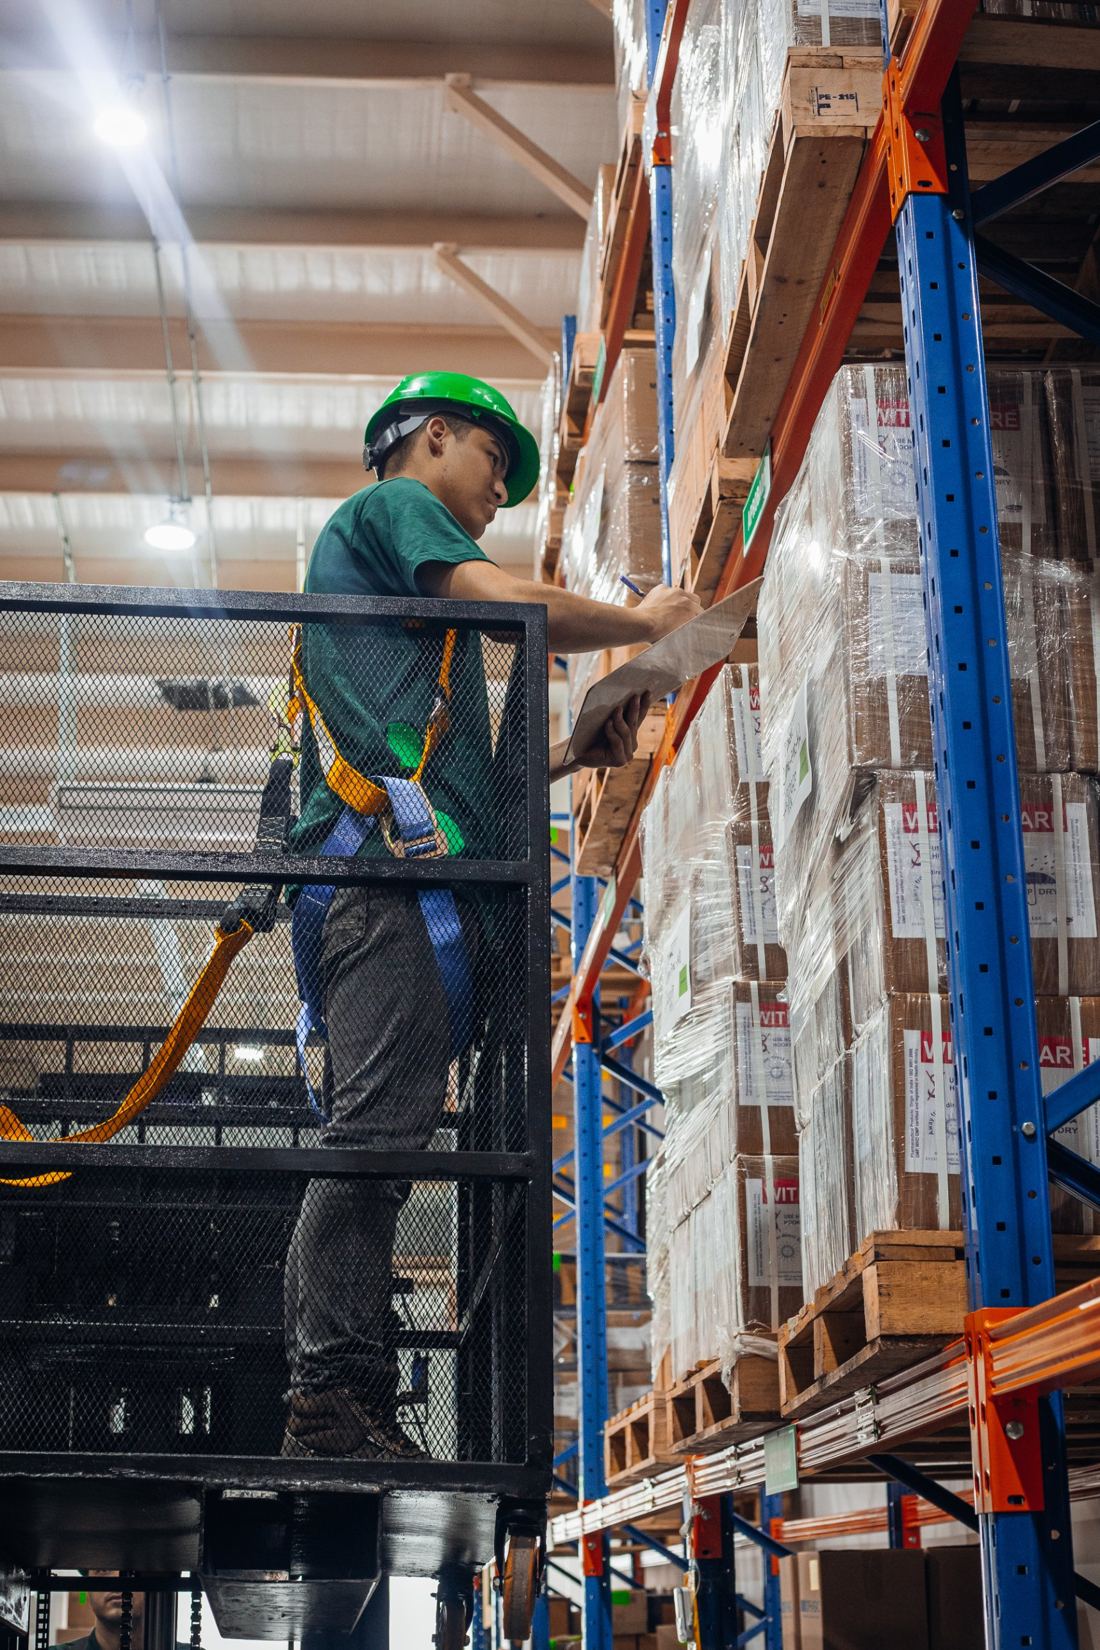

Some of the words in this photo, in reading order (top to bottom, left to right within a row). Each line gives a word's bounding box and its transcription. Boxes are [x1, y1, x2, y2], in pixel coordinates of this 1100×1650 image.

[877, 408, 909, 425] WIT
[991, 411, 1018, 427] RE
[760, 1011, 785, 1025] WIT
[774, 1188, 796, 1201] WIT
